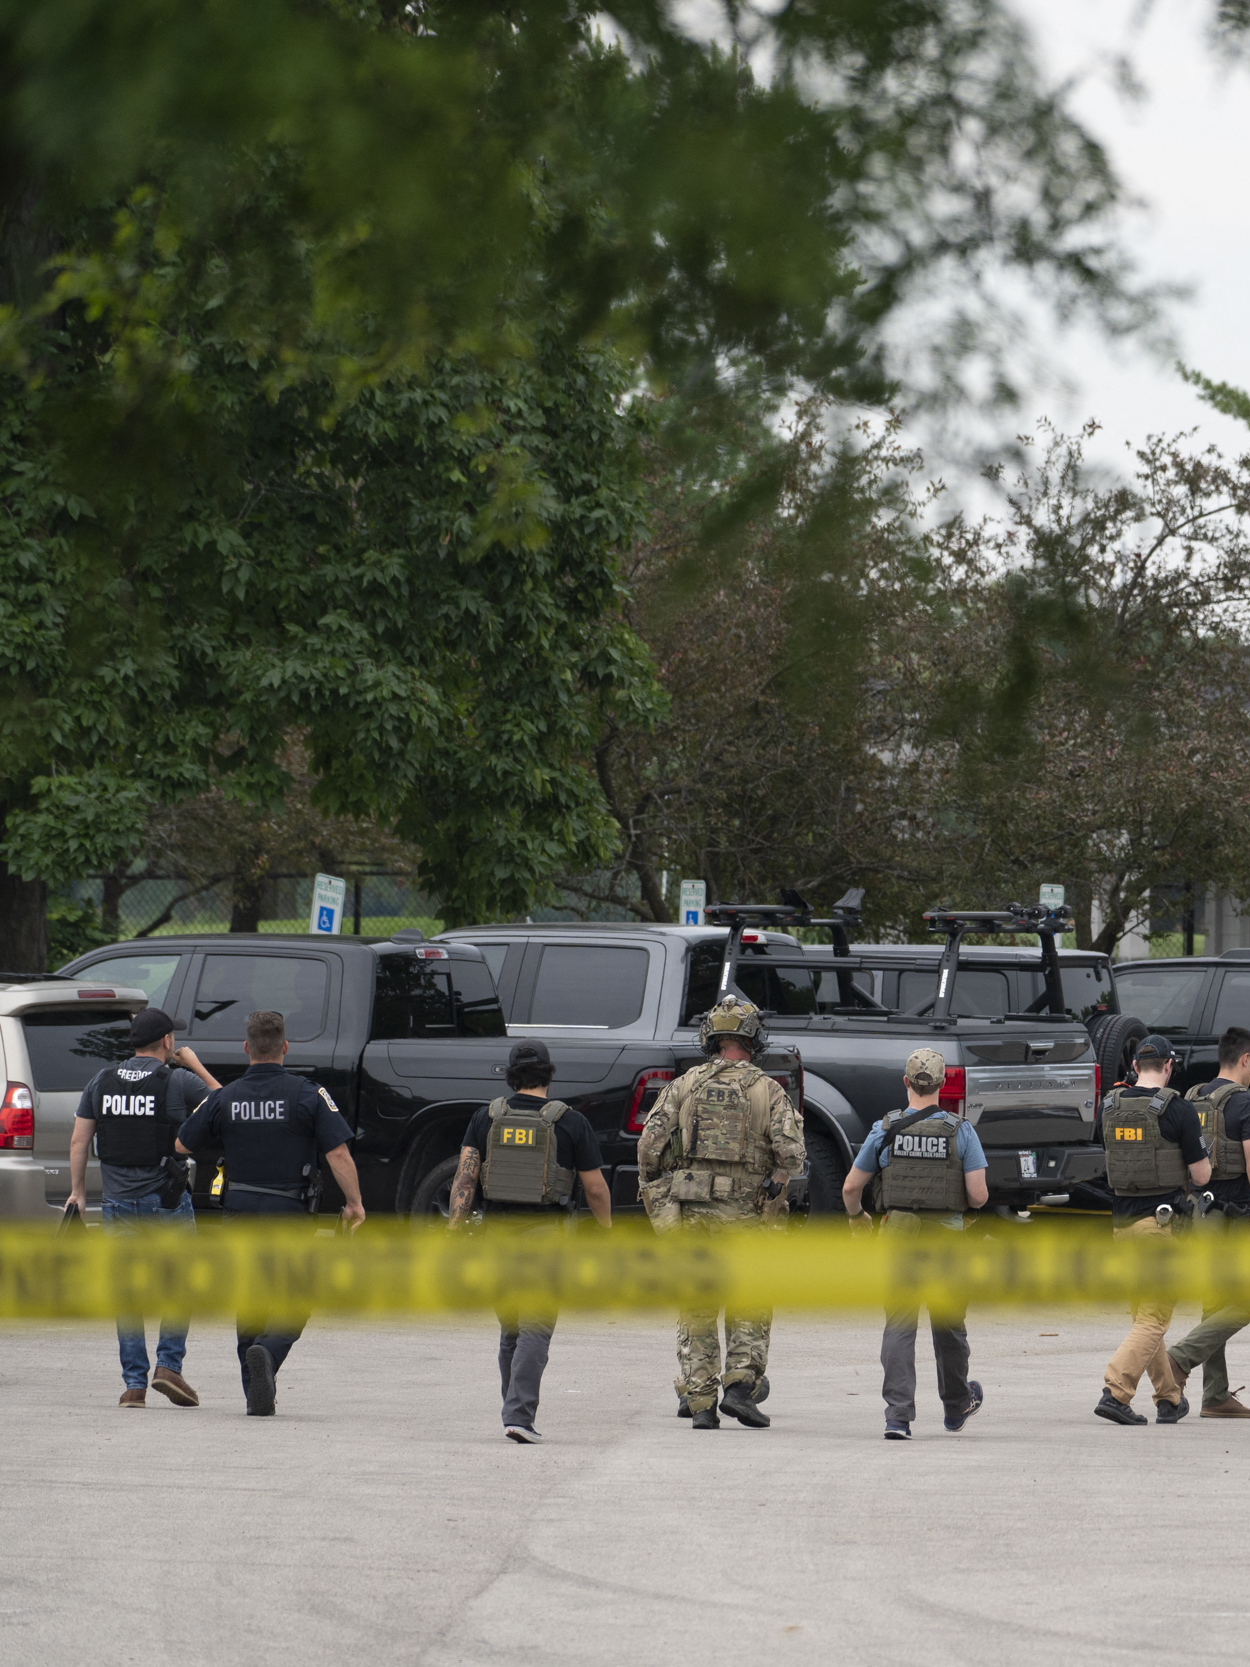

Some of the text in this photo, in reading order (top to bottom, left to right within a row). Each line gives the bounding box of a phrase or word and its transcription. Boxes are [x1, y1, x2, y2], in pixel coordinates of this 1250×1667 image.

[317, 881, 343, 895] RESERVED
[317, 893, 340, 906] PARKING
[706, 1089, 738, 1103] FBI
[102, 1095, 155, 1115] POLICE
[231, 1101, 285, 1120] POLICE
[503, 1128, 533, 1145] FBI
[1115, 1128, 1143, 1141] FBI
[894, 1134, 947, 1153] POLICE
